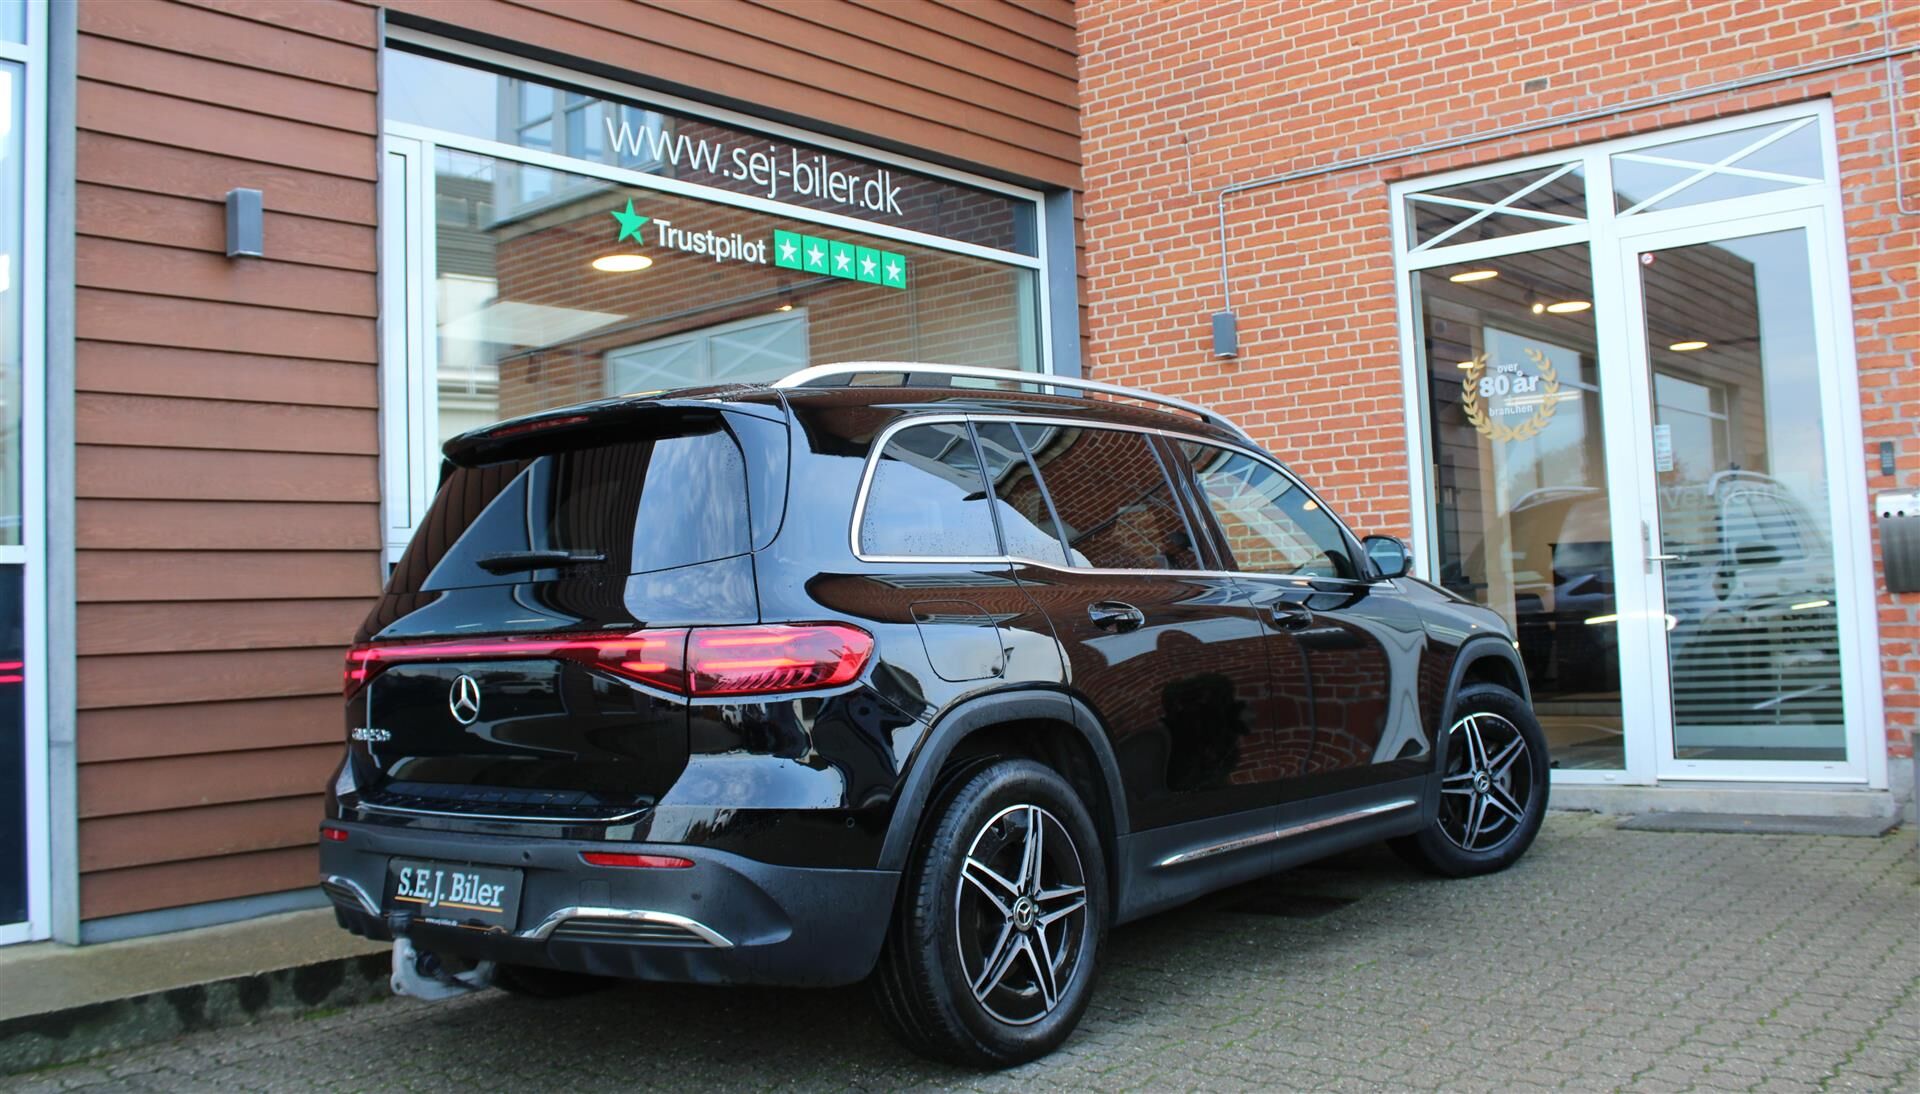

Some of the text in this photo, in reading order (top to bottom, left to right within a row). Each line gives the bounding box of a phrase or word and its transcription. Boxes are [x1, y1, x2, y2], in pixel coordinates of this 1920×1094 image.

[606, 117, 903, 216] www.sej-biler.dk
[653, 219, 766, 264] Trustpilot
[1479, 370, 1540, 398] 80 år
[1497, 363, 1519, 374] over
[1488, 404, 1533, 417] branchen
[397, 867, 504, 907] S.E.J. Biler
